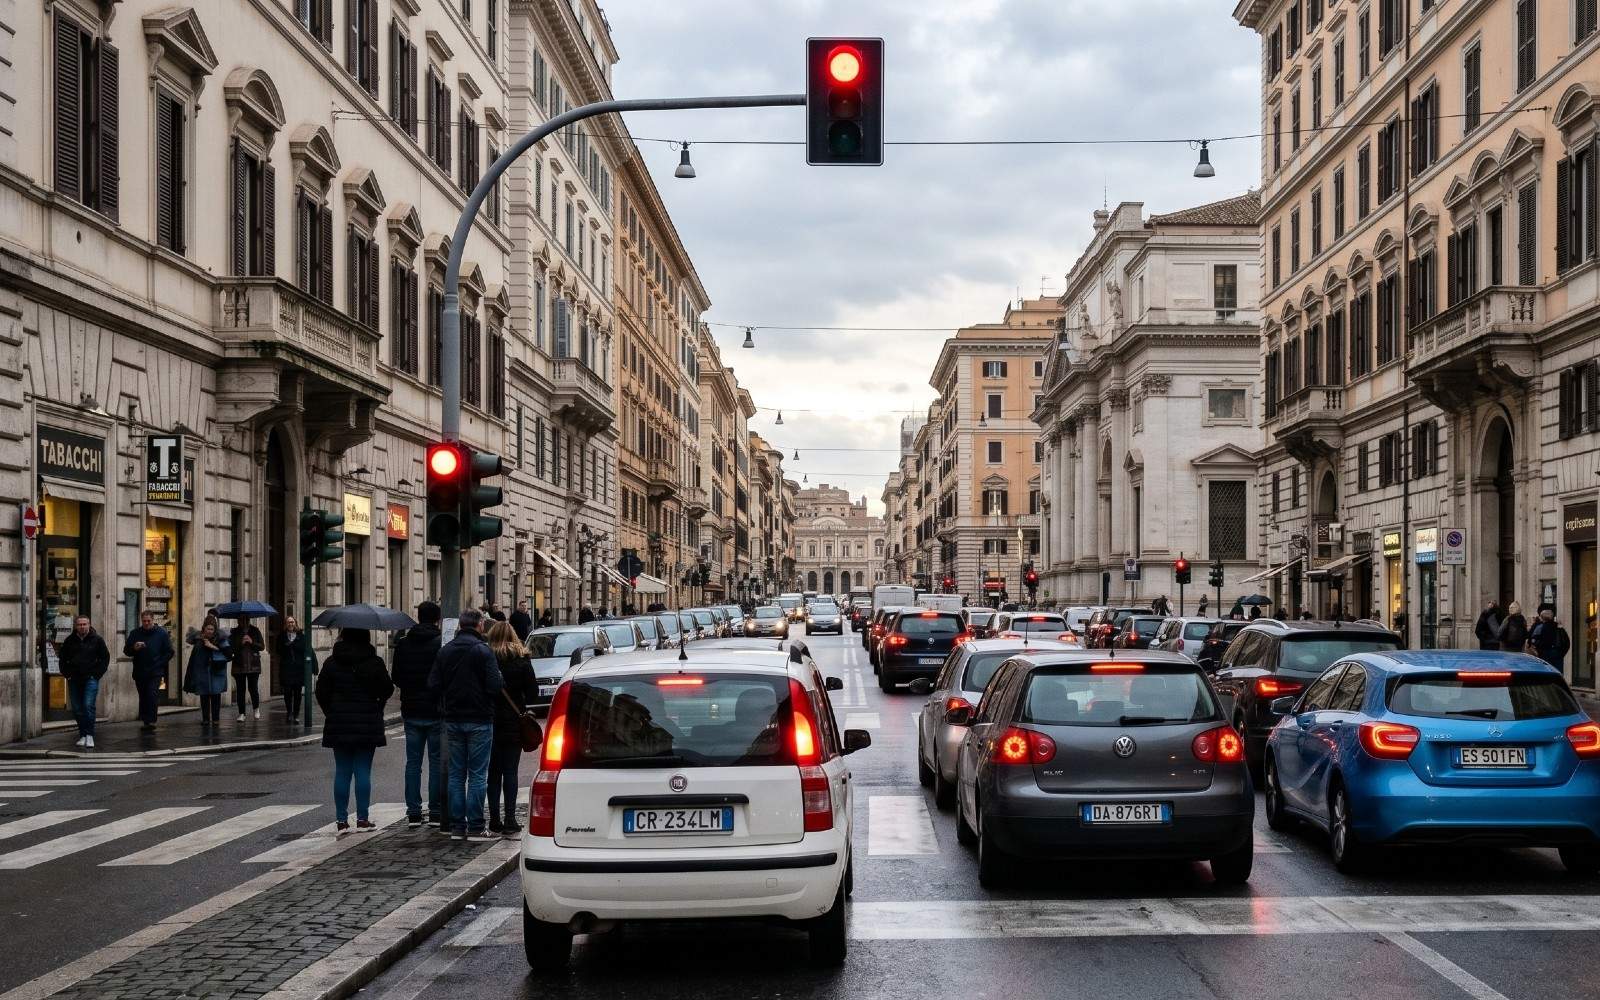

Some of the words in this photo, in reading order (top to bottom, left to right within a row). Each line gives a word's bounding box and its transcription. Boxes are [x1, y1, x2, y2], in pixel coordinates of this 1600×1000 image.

[41, 439, 102, 473] TABACCHI
[153, 438, 177, 477] T
[1462, 749, 1478, 763] ES
